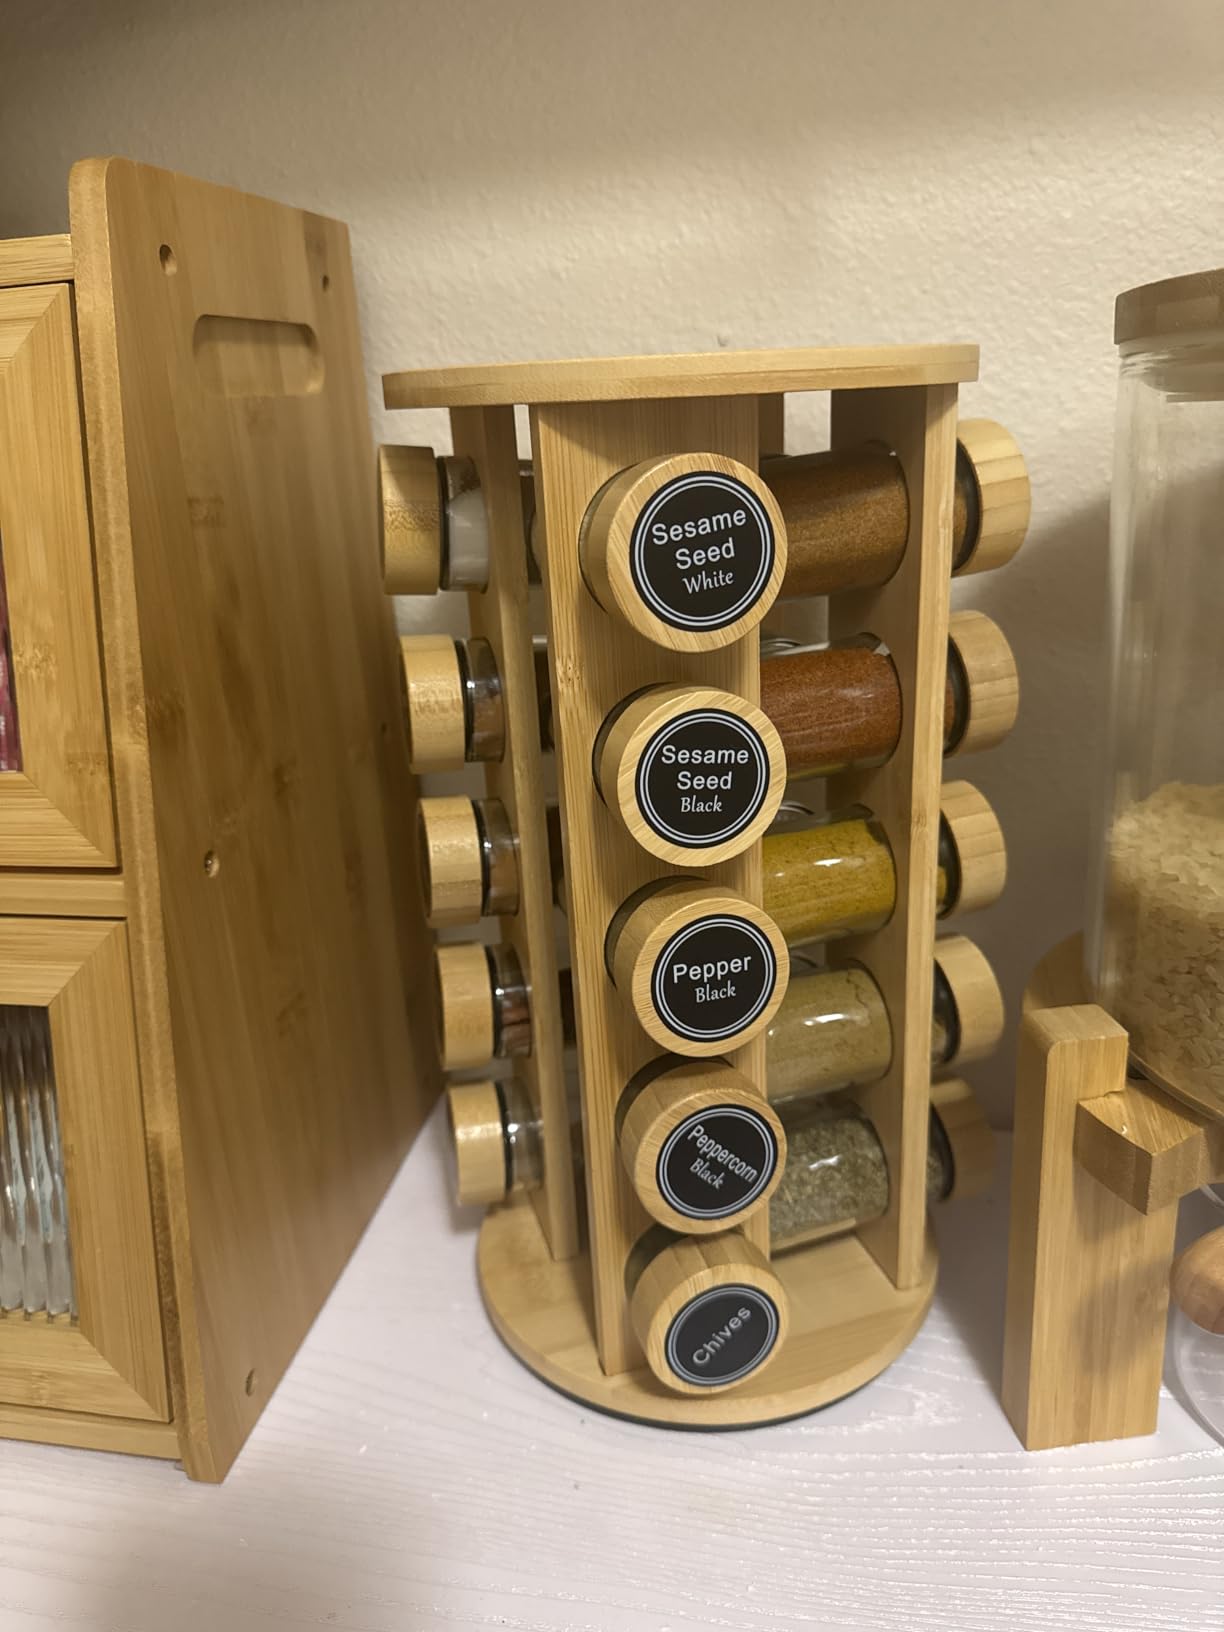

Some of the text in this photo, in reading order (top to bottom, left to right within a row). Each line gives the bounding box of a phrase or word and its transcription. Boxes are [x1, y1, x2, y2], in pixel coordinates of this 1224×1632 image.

[651, 508, 747, 546] Sesame
[675, 536, 735, 570] Seed
[682, 569, 734, 594] White
[661, 744, 749, 764] Sesame
[676, 770, 733, 790] Seed
[680, 794, 723, 813] Black
[672, 955, 752, 984] Pepper
[694, 980, 737, 1003] Black
[687, 1124, 758, 1184] Peppercorn
[689, 1157, 725, 1190] Black
[692, 1306, 751, 1366] Chives
